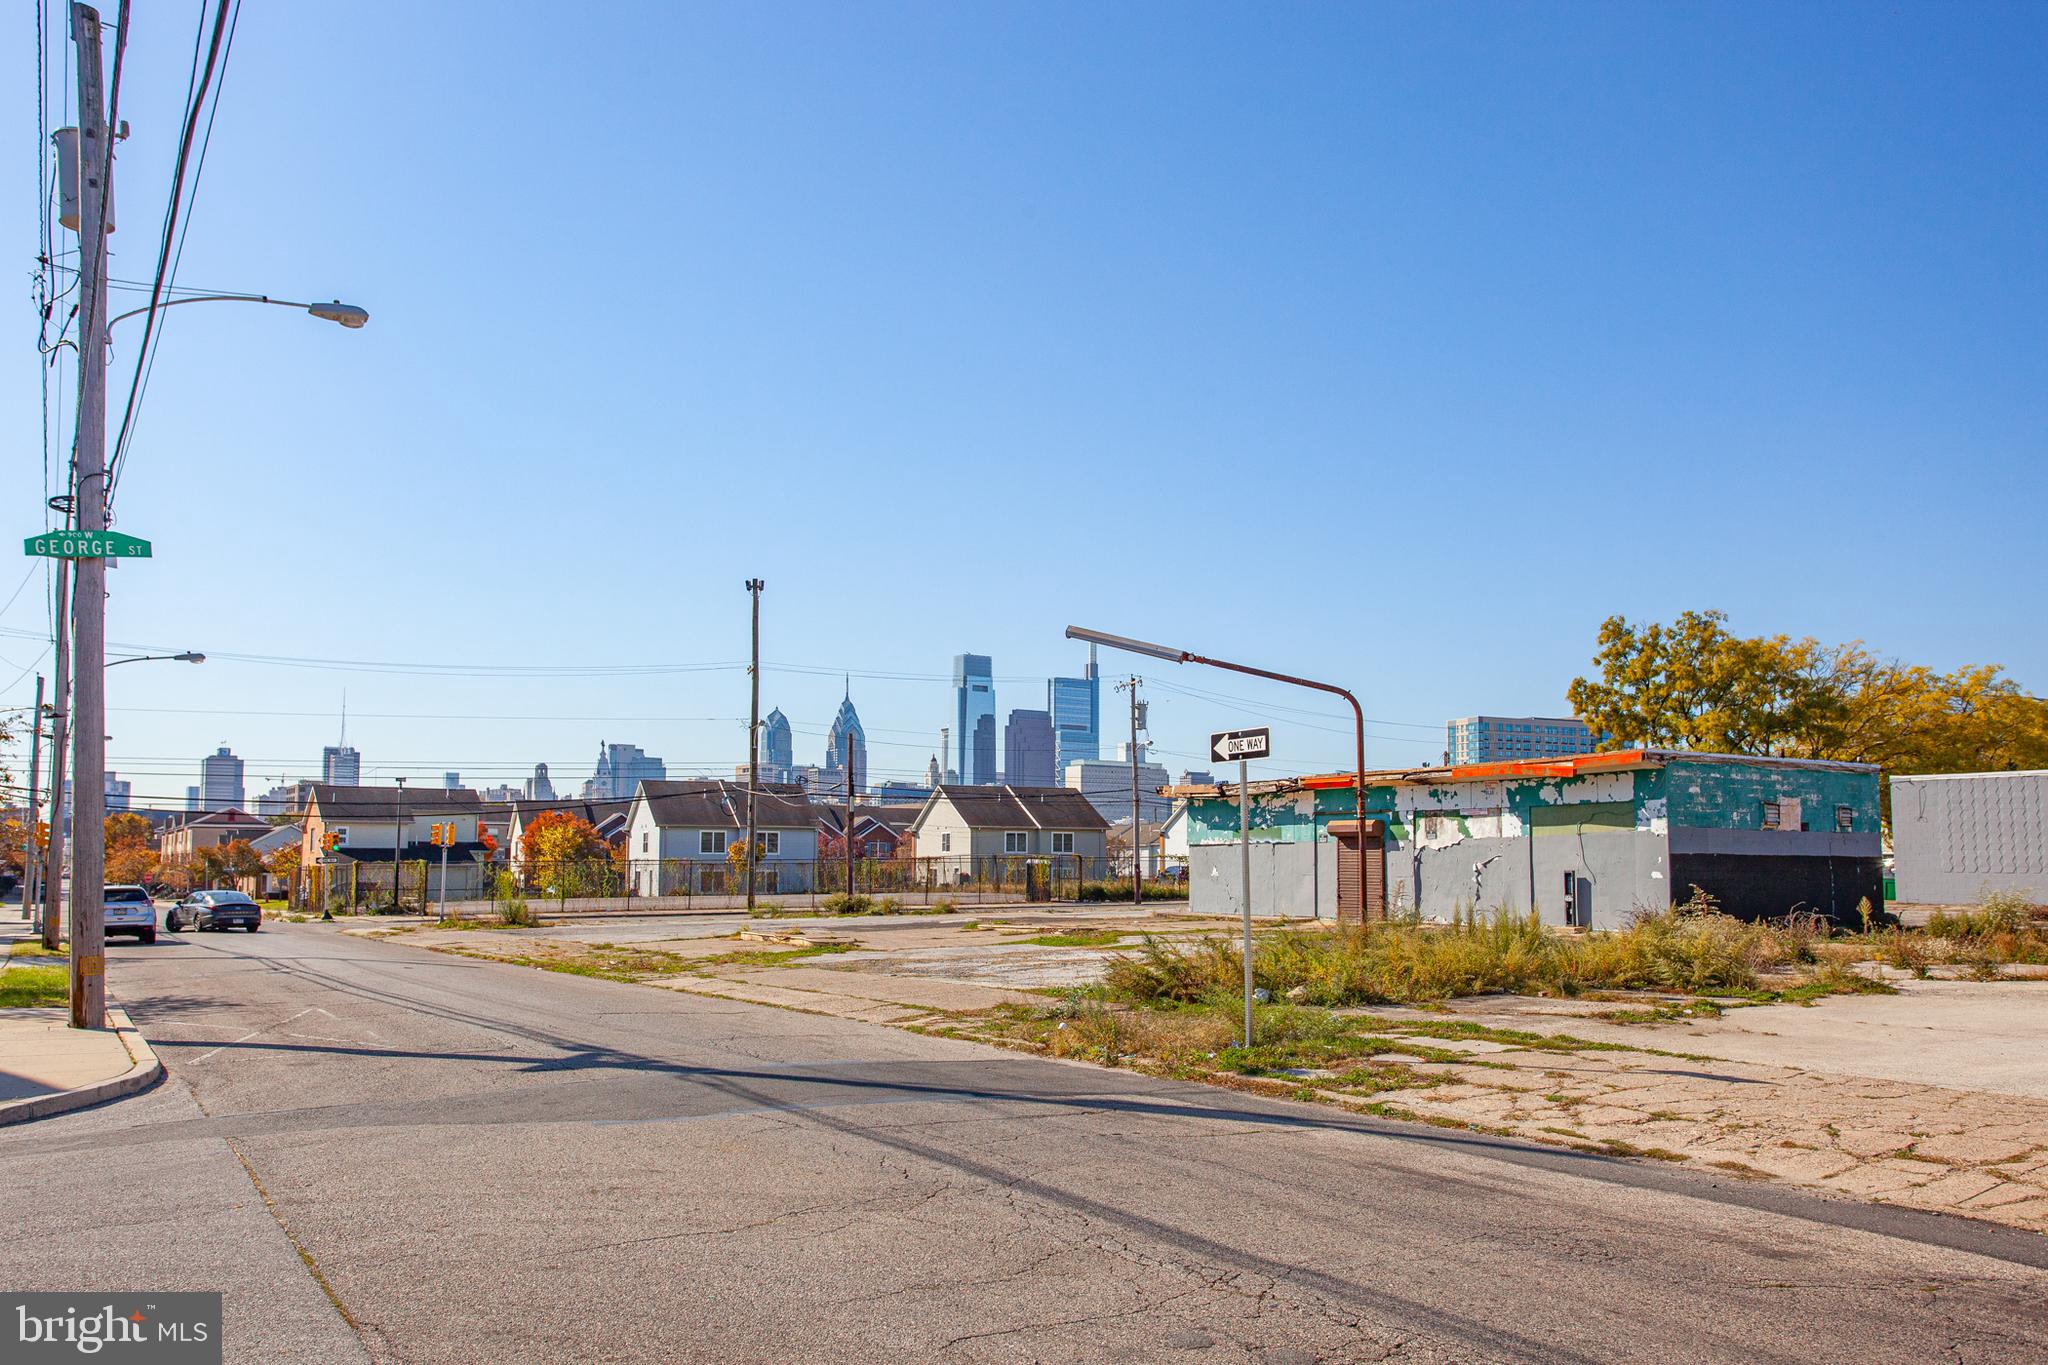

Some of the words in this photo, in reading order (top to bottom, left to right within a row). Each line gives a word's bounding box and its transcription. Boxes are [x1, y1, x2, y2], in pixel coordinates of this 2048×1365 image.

[84, 531, 94, 539] W
[35, 539, 116, 555] GEORGE
[128, 545, 143, 556] ST
[1228, 739, 1244, 752] ONE
[1246, 737, 1263, 750] WAY
